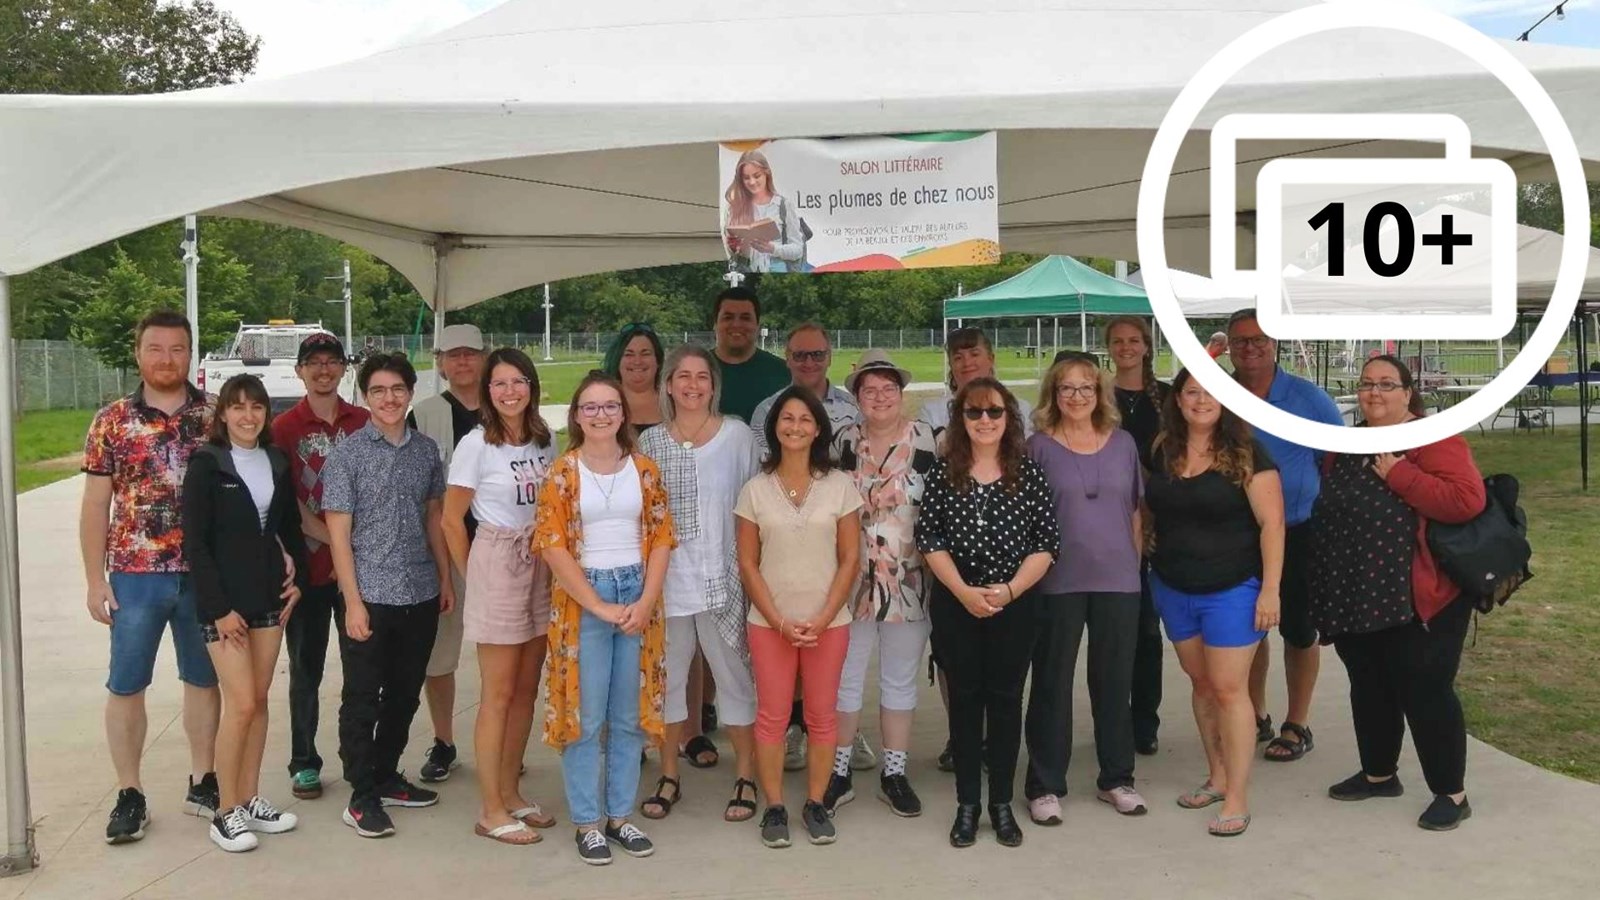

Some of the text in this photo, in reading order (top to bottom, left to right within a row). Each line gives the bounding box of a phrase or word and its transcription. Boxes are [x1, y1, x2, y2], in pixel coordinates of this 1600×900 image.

[841, 156, 944, 175] SALON LITTÉRAIRE
[797, 185, 995, 215] Les plumes de chez nous
[516, 482, 540, 506] LO
